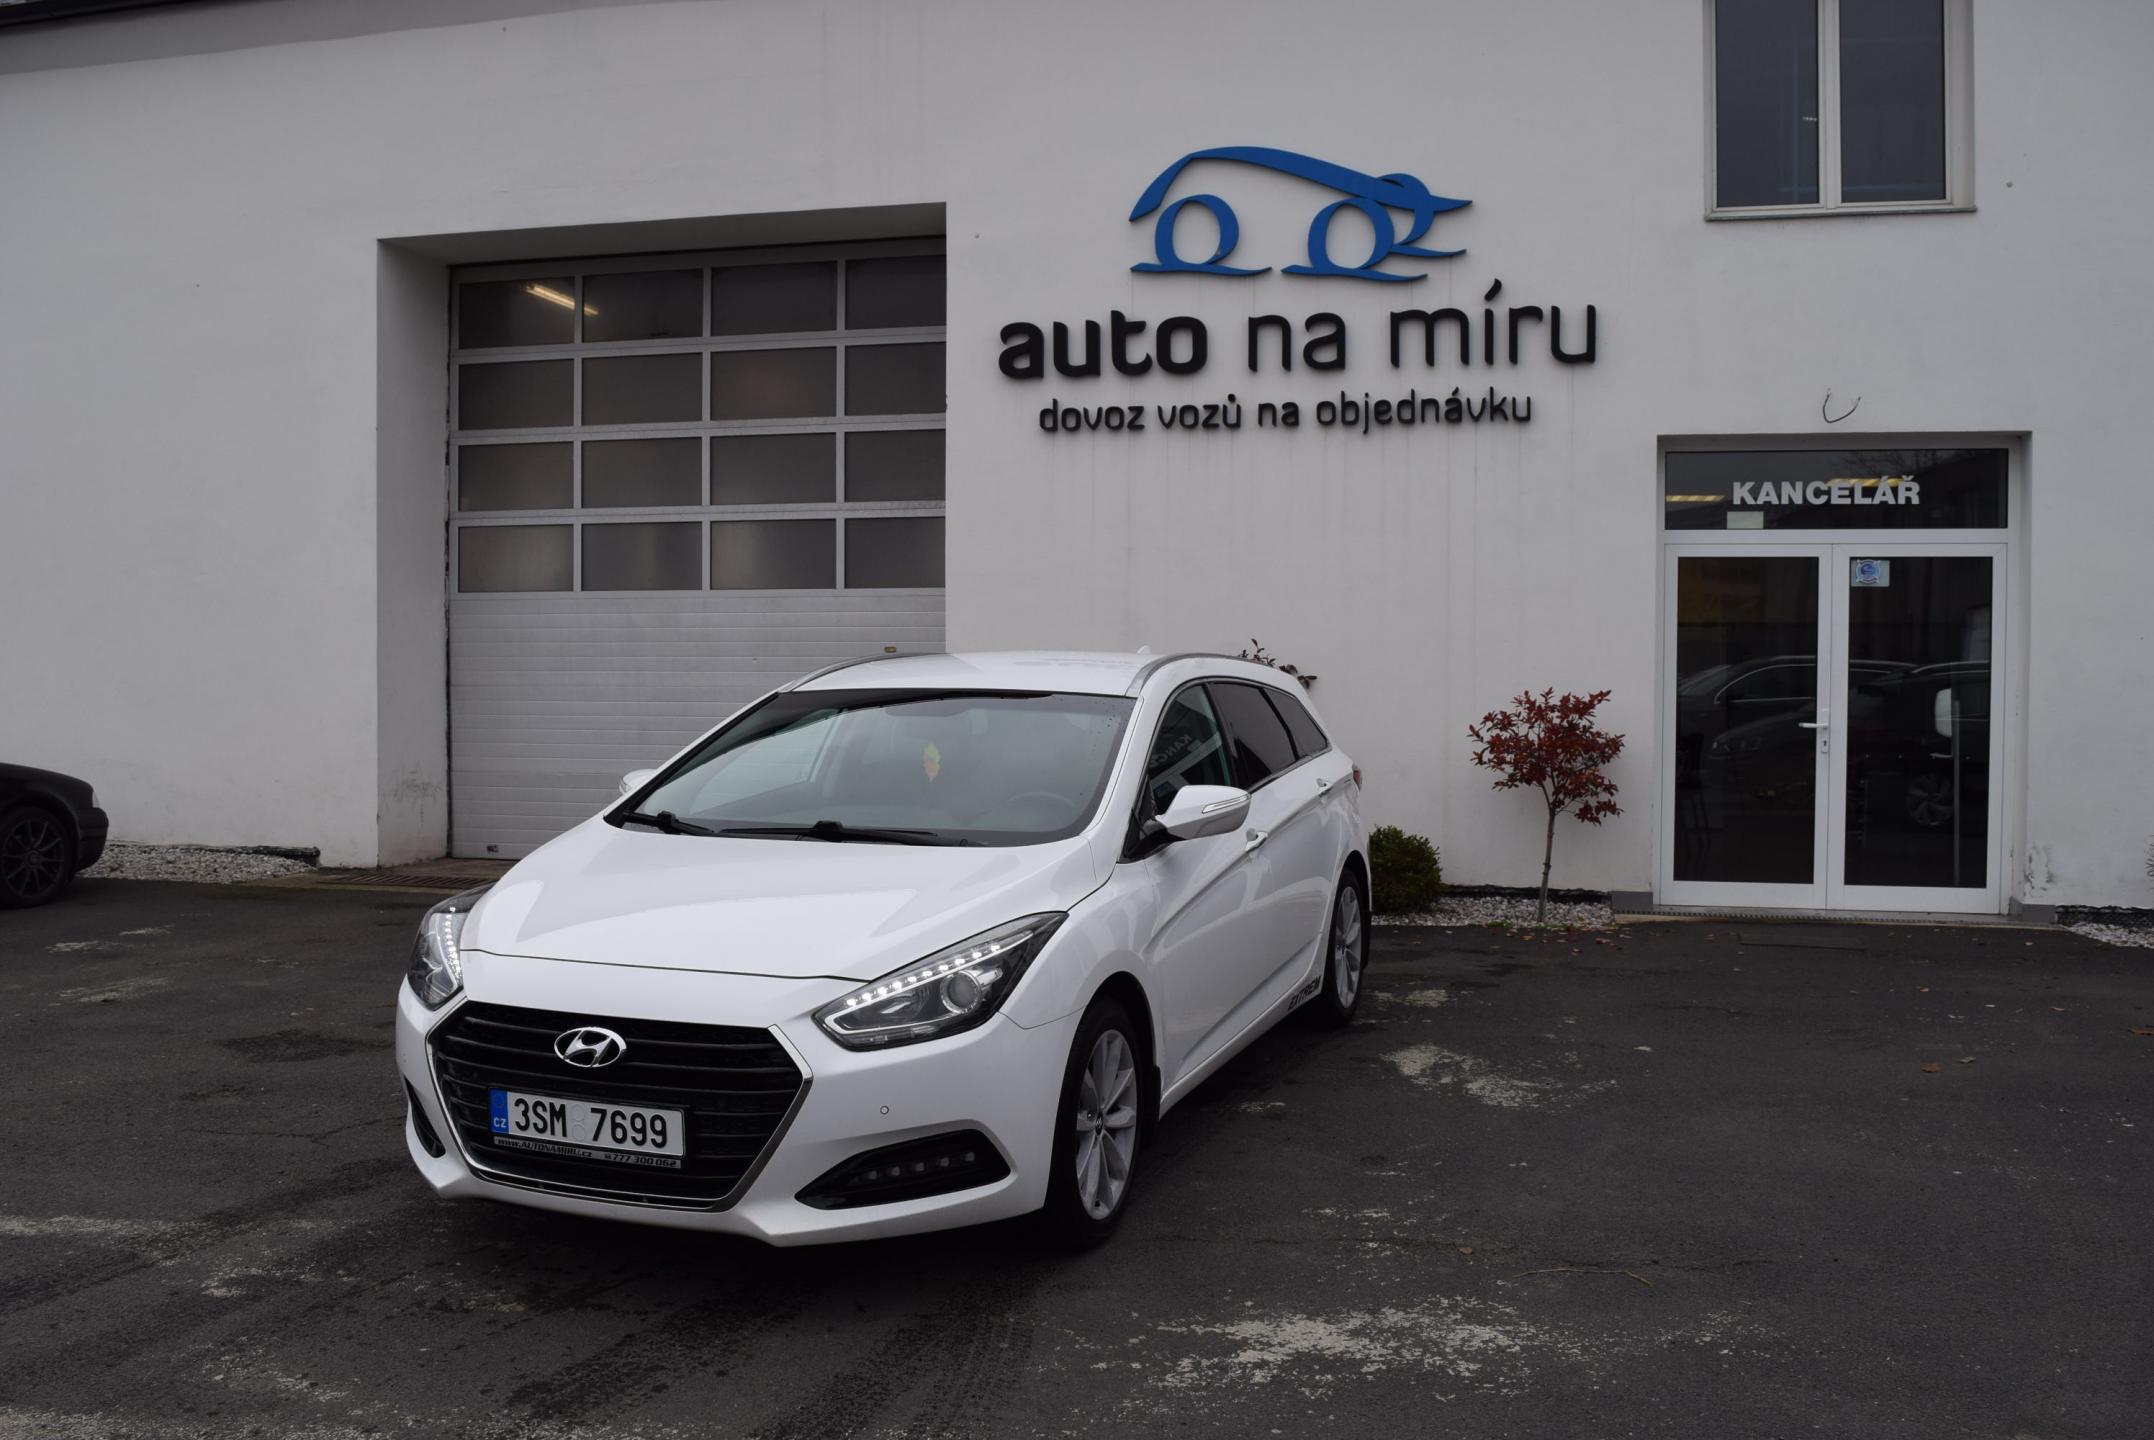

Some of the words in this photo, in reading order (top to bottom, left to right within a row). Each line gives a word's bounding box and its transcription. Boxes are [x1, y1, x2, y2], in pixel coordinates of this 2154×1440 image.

[998, 310, 1208, 381] auto
[1248, 312, 1347, 374] na
[1389, 278, 1597, 370] míru
[1039, 398, 1145, 434] dovoz
[1157, 392, 1242, 432] vozů
[1257, 401, 1301, 430] na
[1315, 386, 1532, 436] objednávku
[1732, 475, 1921, 505] KANCELÁŘ
[493, 1116, 507, 1128] CZ
[514, 1097, 567, 1138] 3SM
[590, 1106, 668, 1149] 7699
